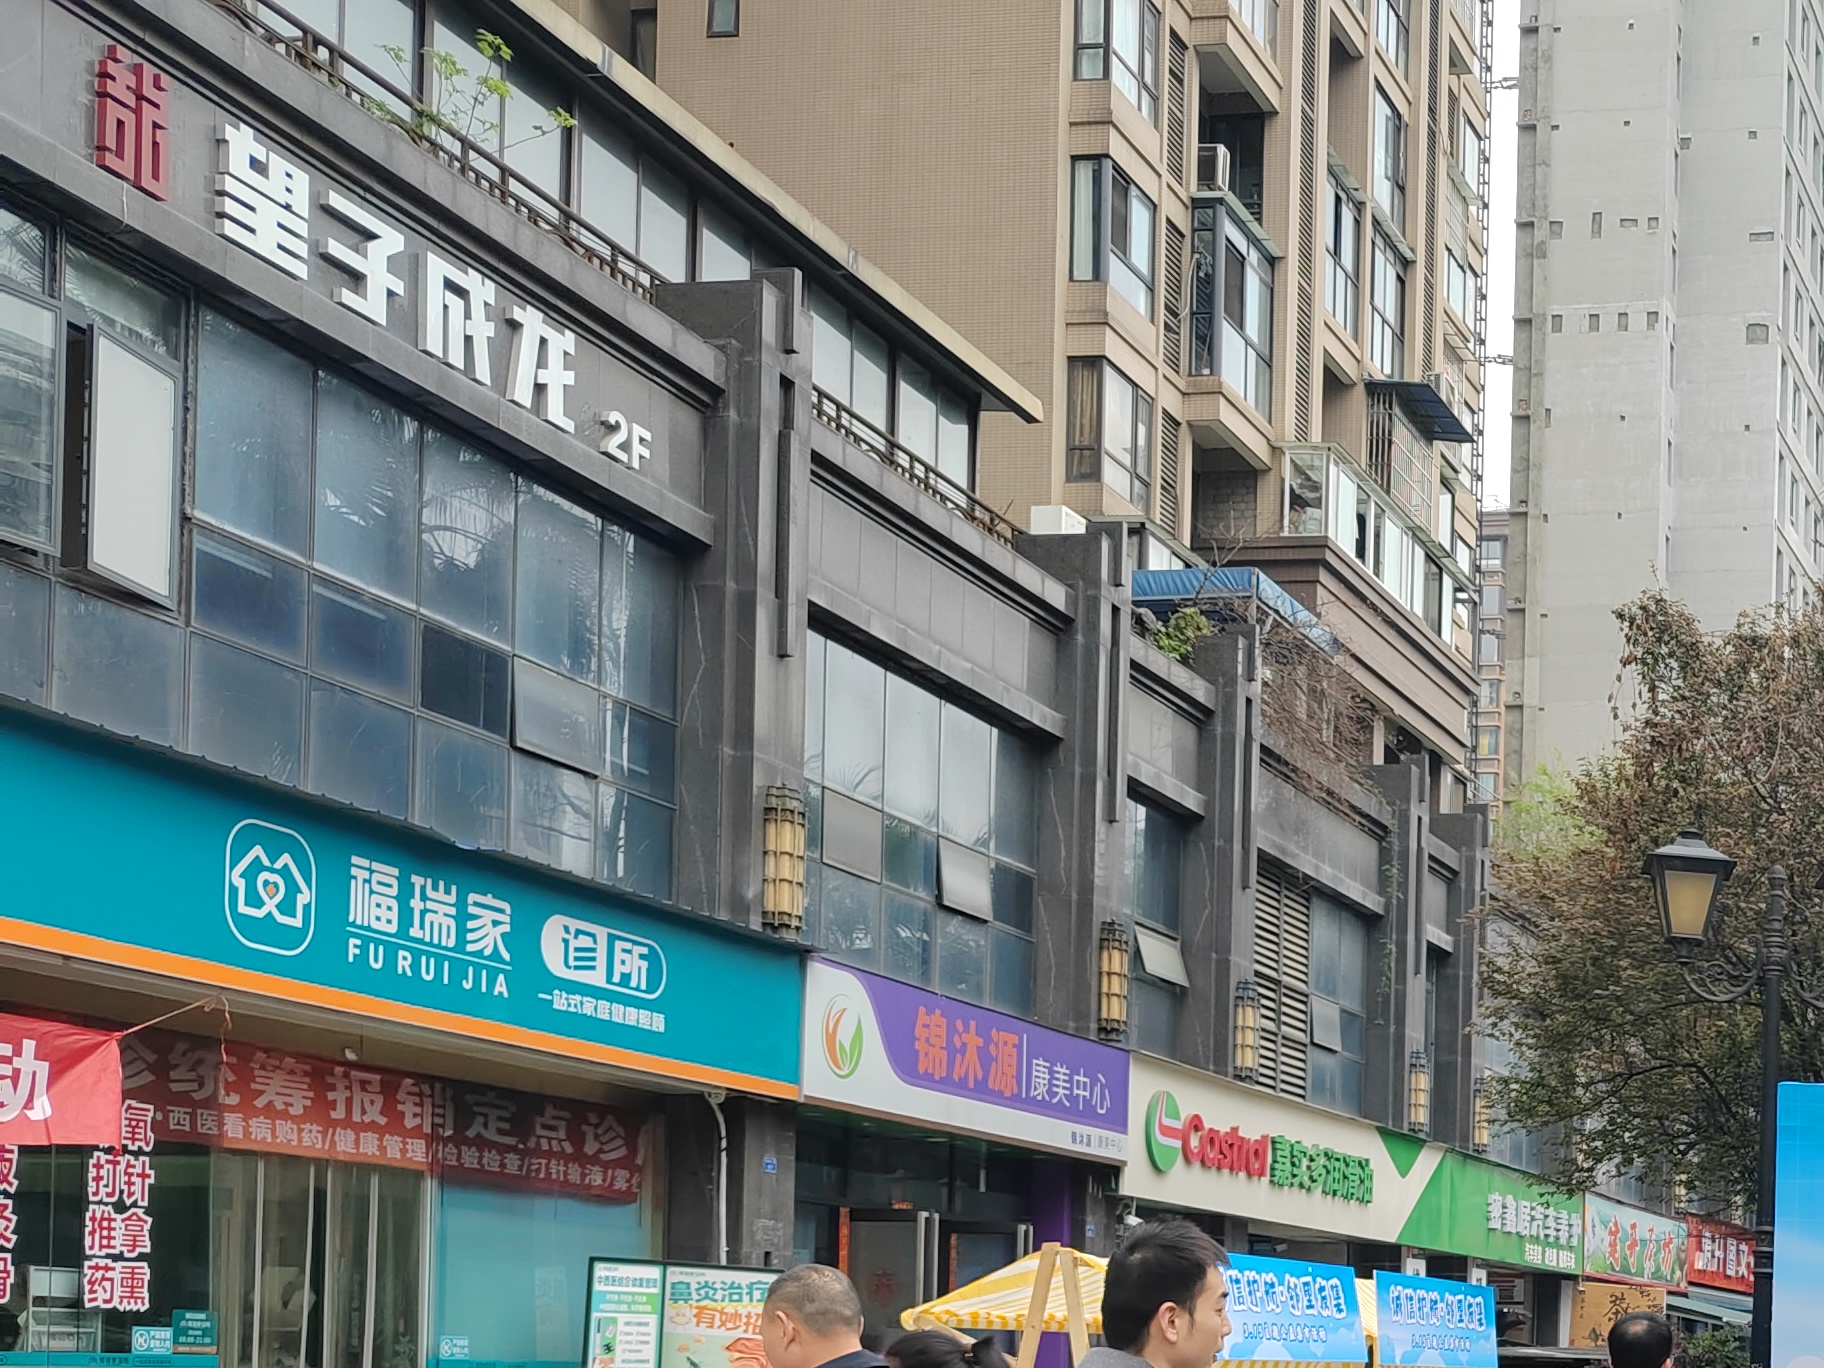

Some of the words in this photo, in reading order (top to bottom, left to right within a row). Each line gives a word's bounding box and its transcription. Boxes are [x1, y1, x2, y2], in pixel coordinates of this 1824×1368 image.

[215, 122, 576, 434] 望子成龙
[600, 411, 652, 470] 2F
[348, 855, 511, 962] 福瑞家
[561, 924, 650, 992] 诊所
[348, 937, 384, 970] FU
[397, 949, 450, 985] RUI
[462, 965, 509, 998] JIA
[537, 988, 666, 1034] 一站式家庭健康照顾
[915, 1005, 1019, 1098] 锦沐源
[1030, 1057, 1111, 1115] 康美中心
[1182, 1113, 1270, 1178] Castrol
[1270, 1135, 1374, 1204] 嘉实多润滑油
[1224, 1268, 1347, 1320] 信护航·邻里友集
